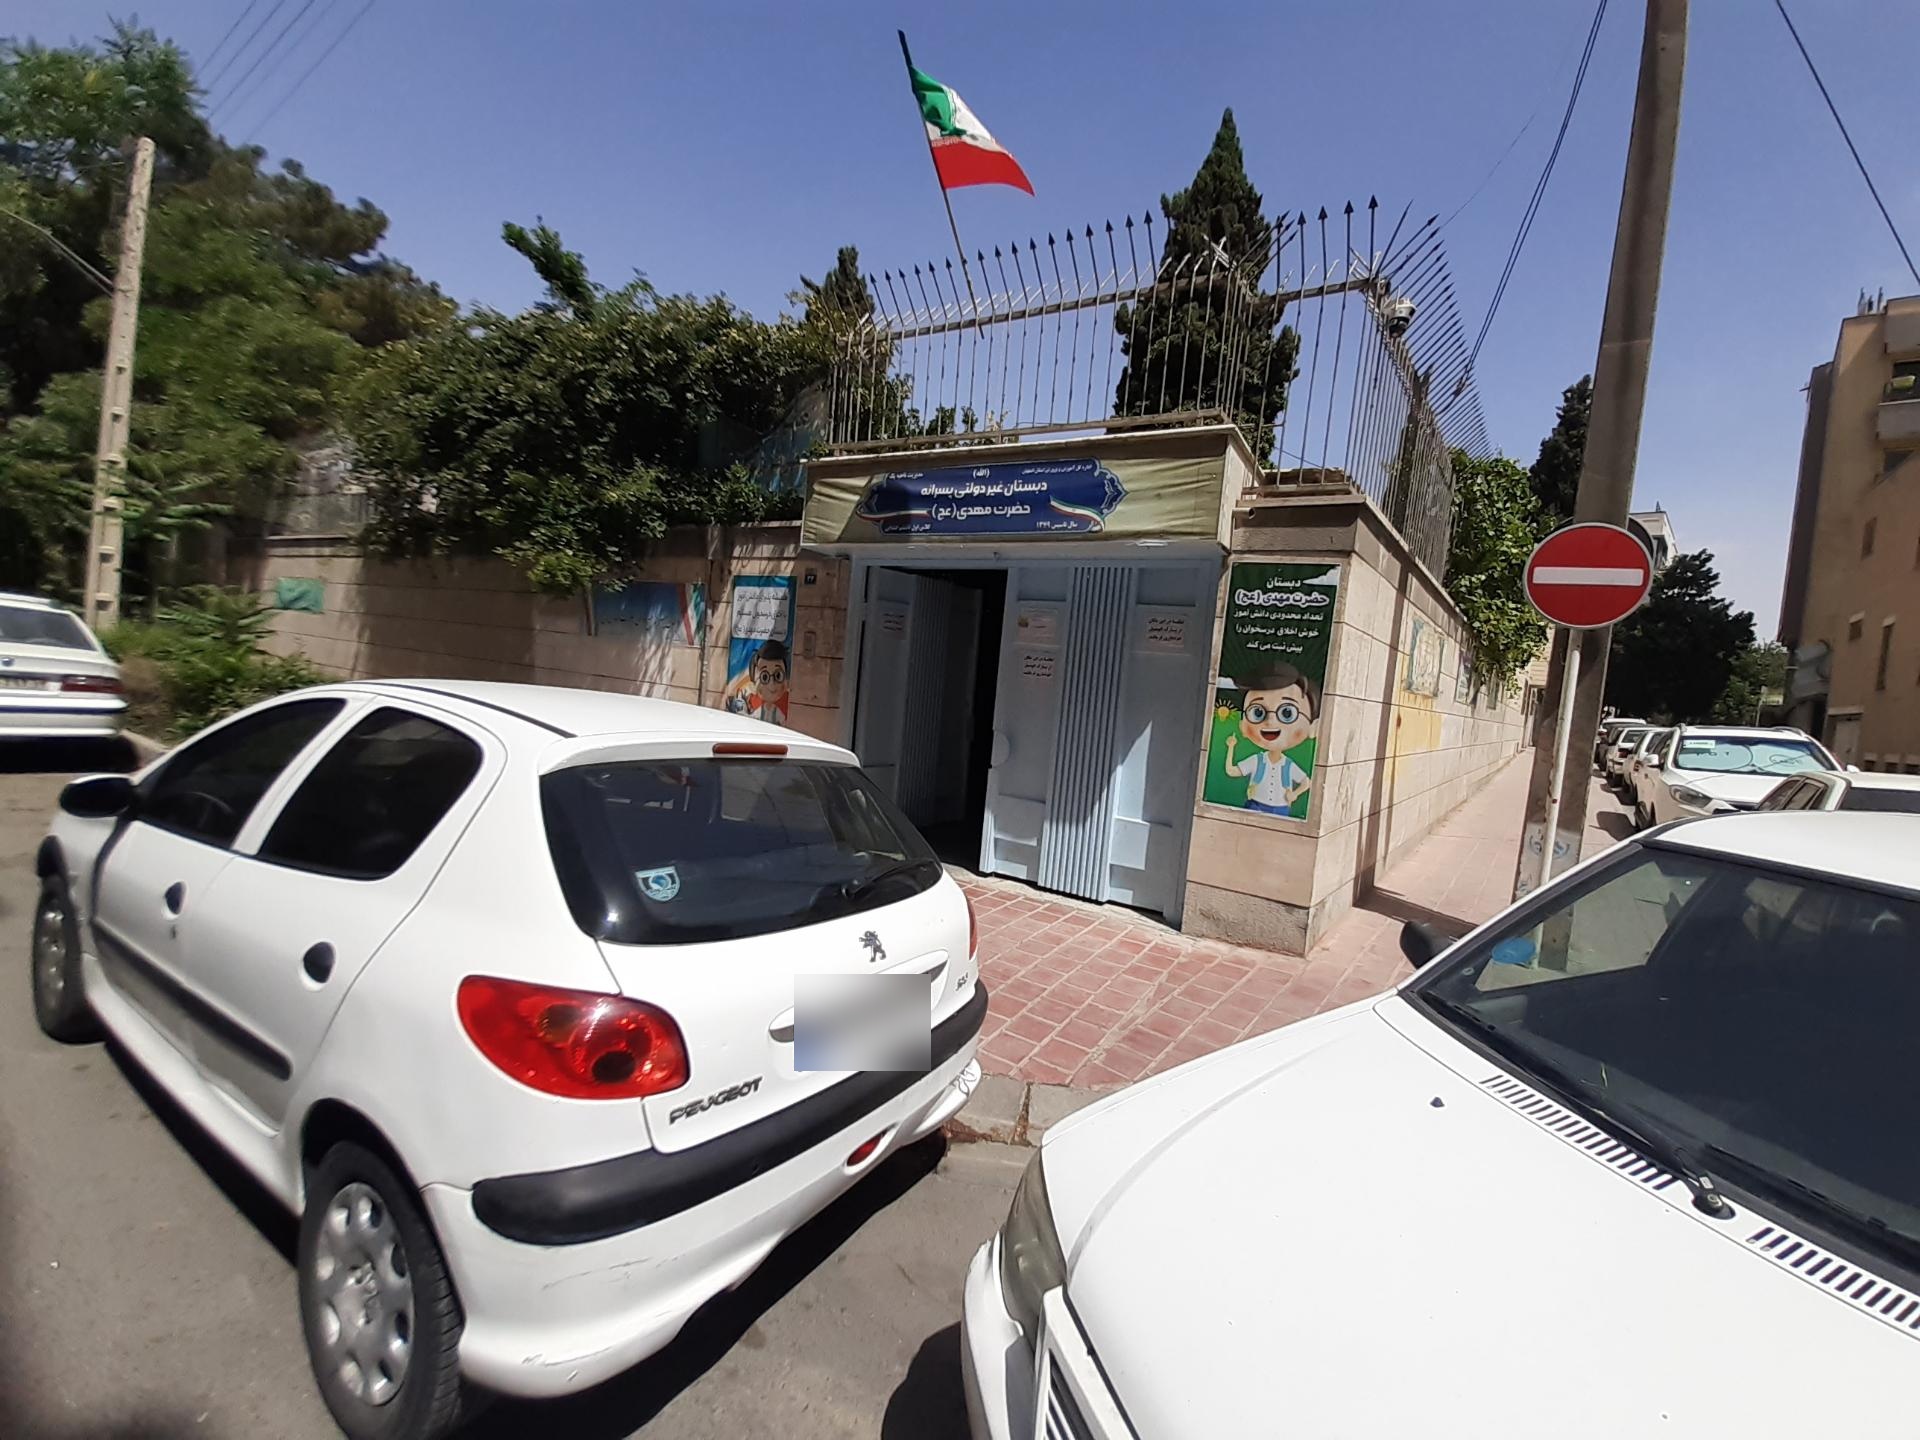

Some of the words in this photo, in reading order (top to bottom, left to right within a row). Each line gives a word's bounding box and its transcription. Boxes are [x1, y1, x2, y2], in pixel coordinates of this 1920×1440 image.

[920, 484, 954, 499] پسرانه
[955, 482, 986, 498] دولتی
[986, 481, 1003, 496] غیر
[1004, 479, 1048, 496] دبستان
[956, 504, 992, 520] مهدی
[993, 502, 1031, 518] حضرت
[1266, 577, 1301, 589] دبستان
[1235, 589, 1262, 605] (عج)
[1262, 591, 1291, 607] مهدی
[1291, 592, 1329, 607] حضرت
[1250, 609, 1269, 618] دانش
[1270, 611, 1302, 620] محدودی
[1302, 612, 1323, 620] تعداد
[1235, 623, 1242, 632] را
[1242, 624, 1275, 634] درسخوان
[1276, 627, 1298, 636] اخلاق
[1298, 628, 1319, 638] خوش
[669, 1076, 763, 1125] PEUGEOT
